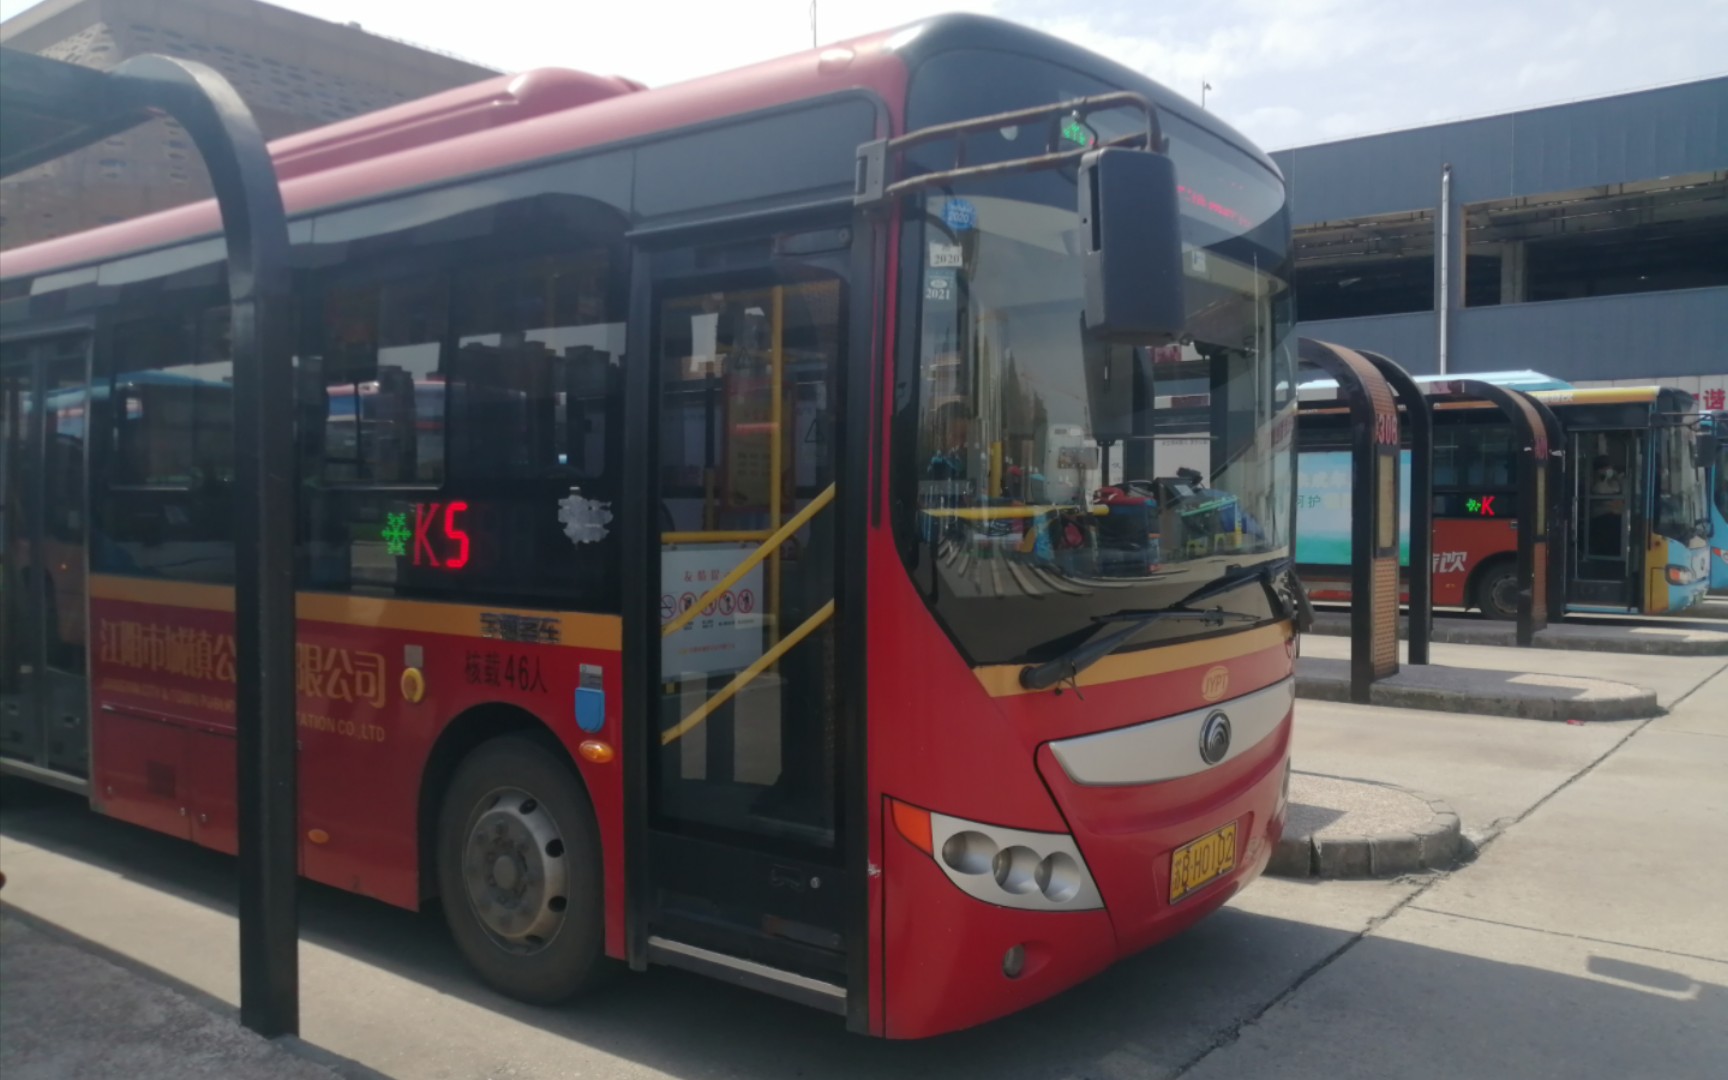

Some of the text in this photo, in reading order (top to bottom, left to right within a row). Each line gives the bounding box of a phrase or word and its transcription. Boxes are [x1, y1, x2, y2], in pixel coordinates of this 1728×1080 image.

[933, 254, 961, 265] 2020
[925, 287, 951, 300] 2021
[412, 501, 470, 569] K5
